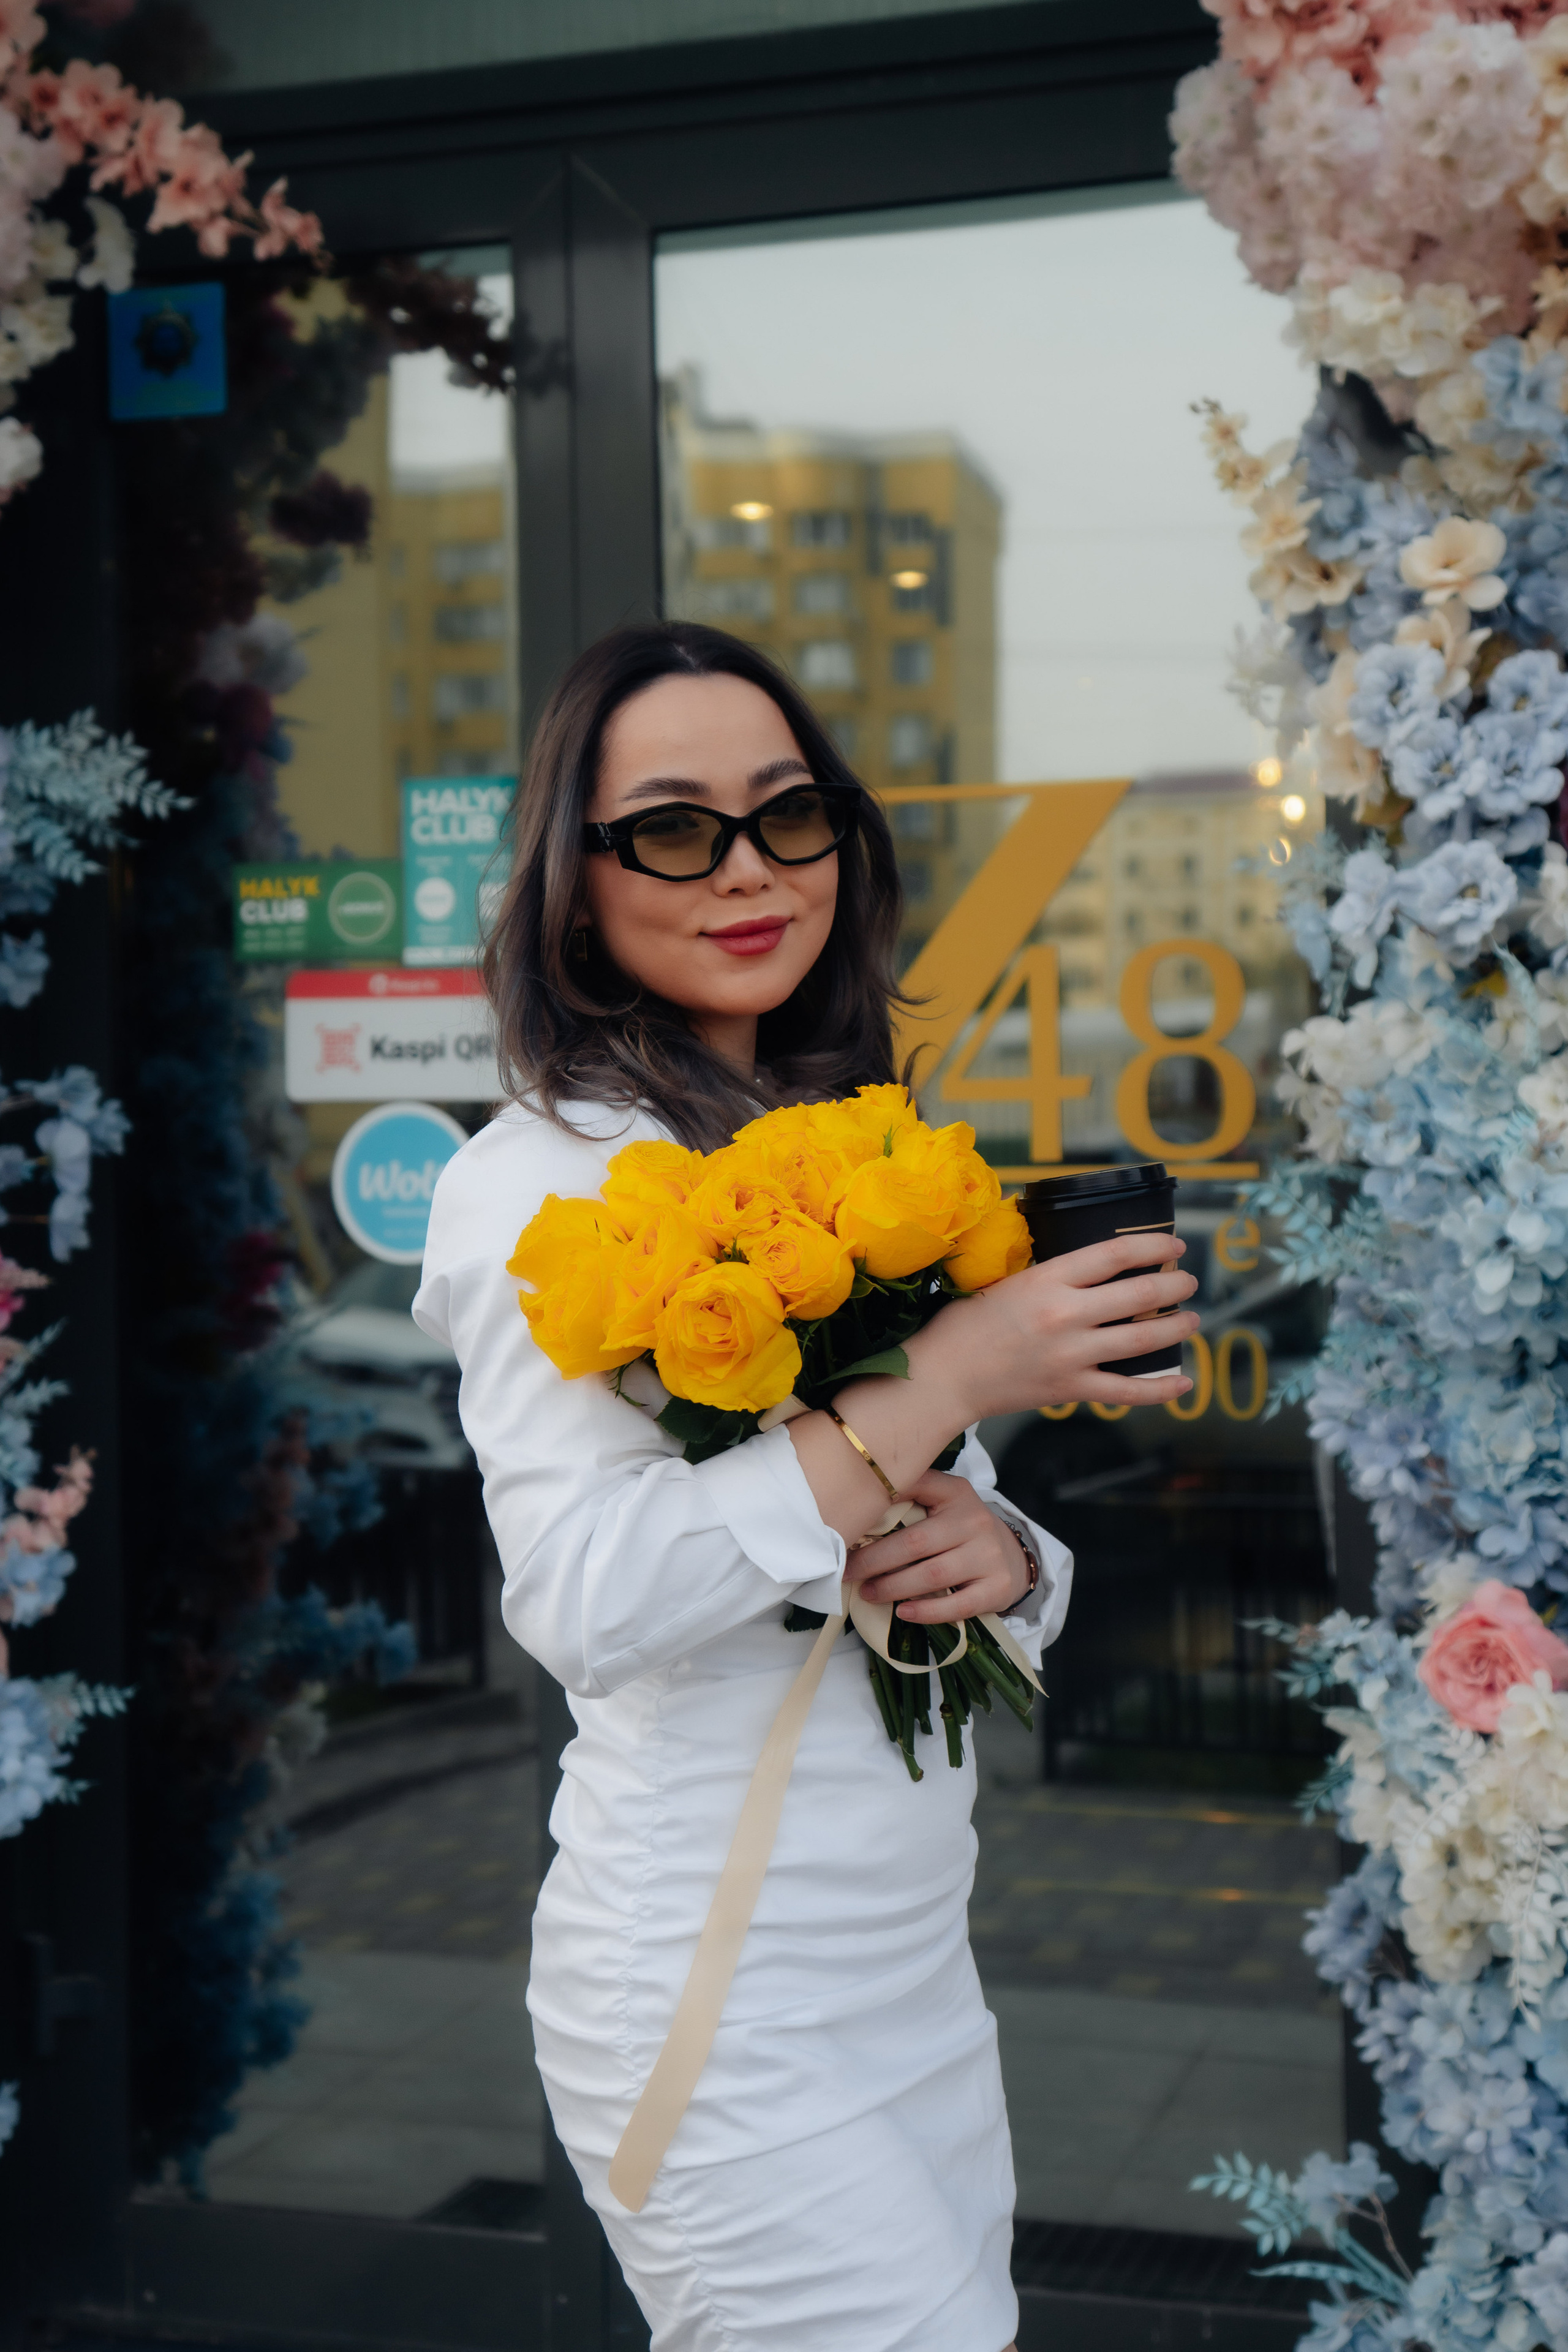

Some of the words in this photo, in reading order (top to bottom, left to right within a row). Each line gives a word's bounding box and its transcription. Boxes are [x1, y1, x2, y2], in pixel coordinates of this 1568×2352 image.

[411, 815, 497, 845] CLUB
[239, 876, 320, 899] HALYK
[239, 898, 308, 925] CLUB
[370, 1033, 446, 1067] Kaspi
